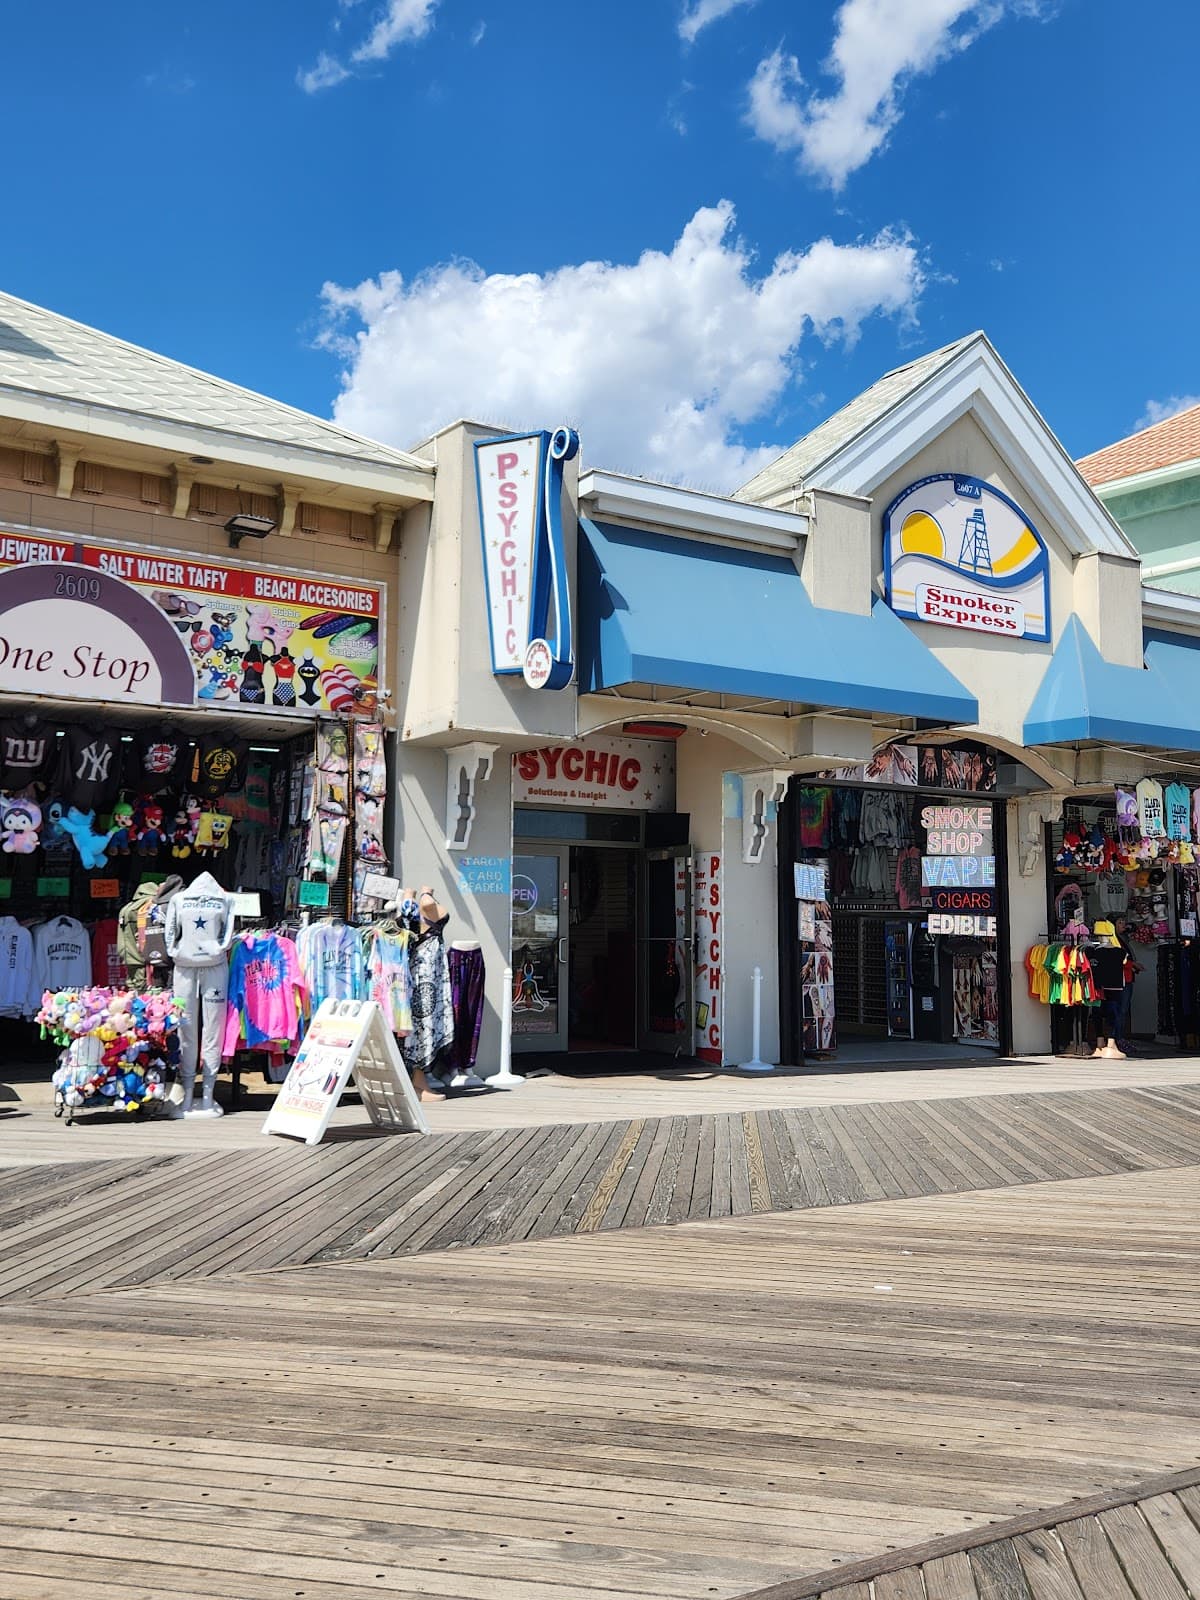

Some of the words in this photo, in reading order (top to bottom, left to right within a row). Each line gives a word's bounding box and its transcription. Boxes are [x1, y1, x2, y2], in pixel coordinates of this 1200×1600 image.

[957, 483, 973, 494] 2607
[0, 538, 66, 562] JEWERLY
[497, 452, 519, 655] PSYCHIC
[99, 553, 134, 577] SALT
[137, 559, 184, 584] WATER
[187, 566, 228, 590] TAFFY
[56, 573, 100, 600] 2609
[254, 577, 297, 601] BEACH
[300, 582, 373, 612] ACCESORIES
[272, 607, 300, 618] Bubble
[926, 587, 1015, 615] Smoker
[279, 618, 300, 629] Guns
[923, 601, 1017, 630] Express
[63, 645, 150, 693] Stop
[76, 741, 112, 782] NY
[513, 747, 641, 791] SYCHIC
[528, 787, 568, 798] Solutions
[578, 790, 607, 801] Insight
[921, 807, 993, 830] SMOKE
[927, 832, 983, 854] SHOP
[468, 871, 502, 881] CARD
[923, 856, 995, 886] VAPE
[512, 888, 536, 901] PEN
[937, 892, 991, 909] CIGARS
[928, 913, 996, 936] EDIBLE
[709, 856, 721, 1047] PSYCHIC
